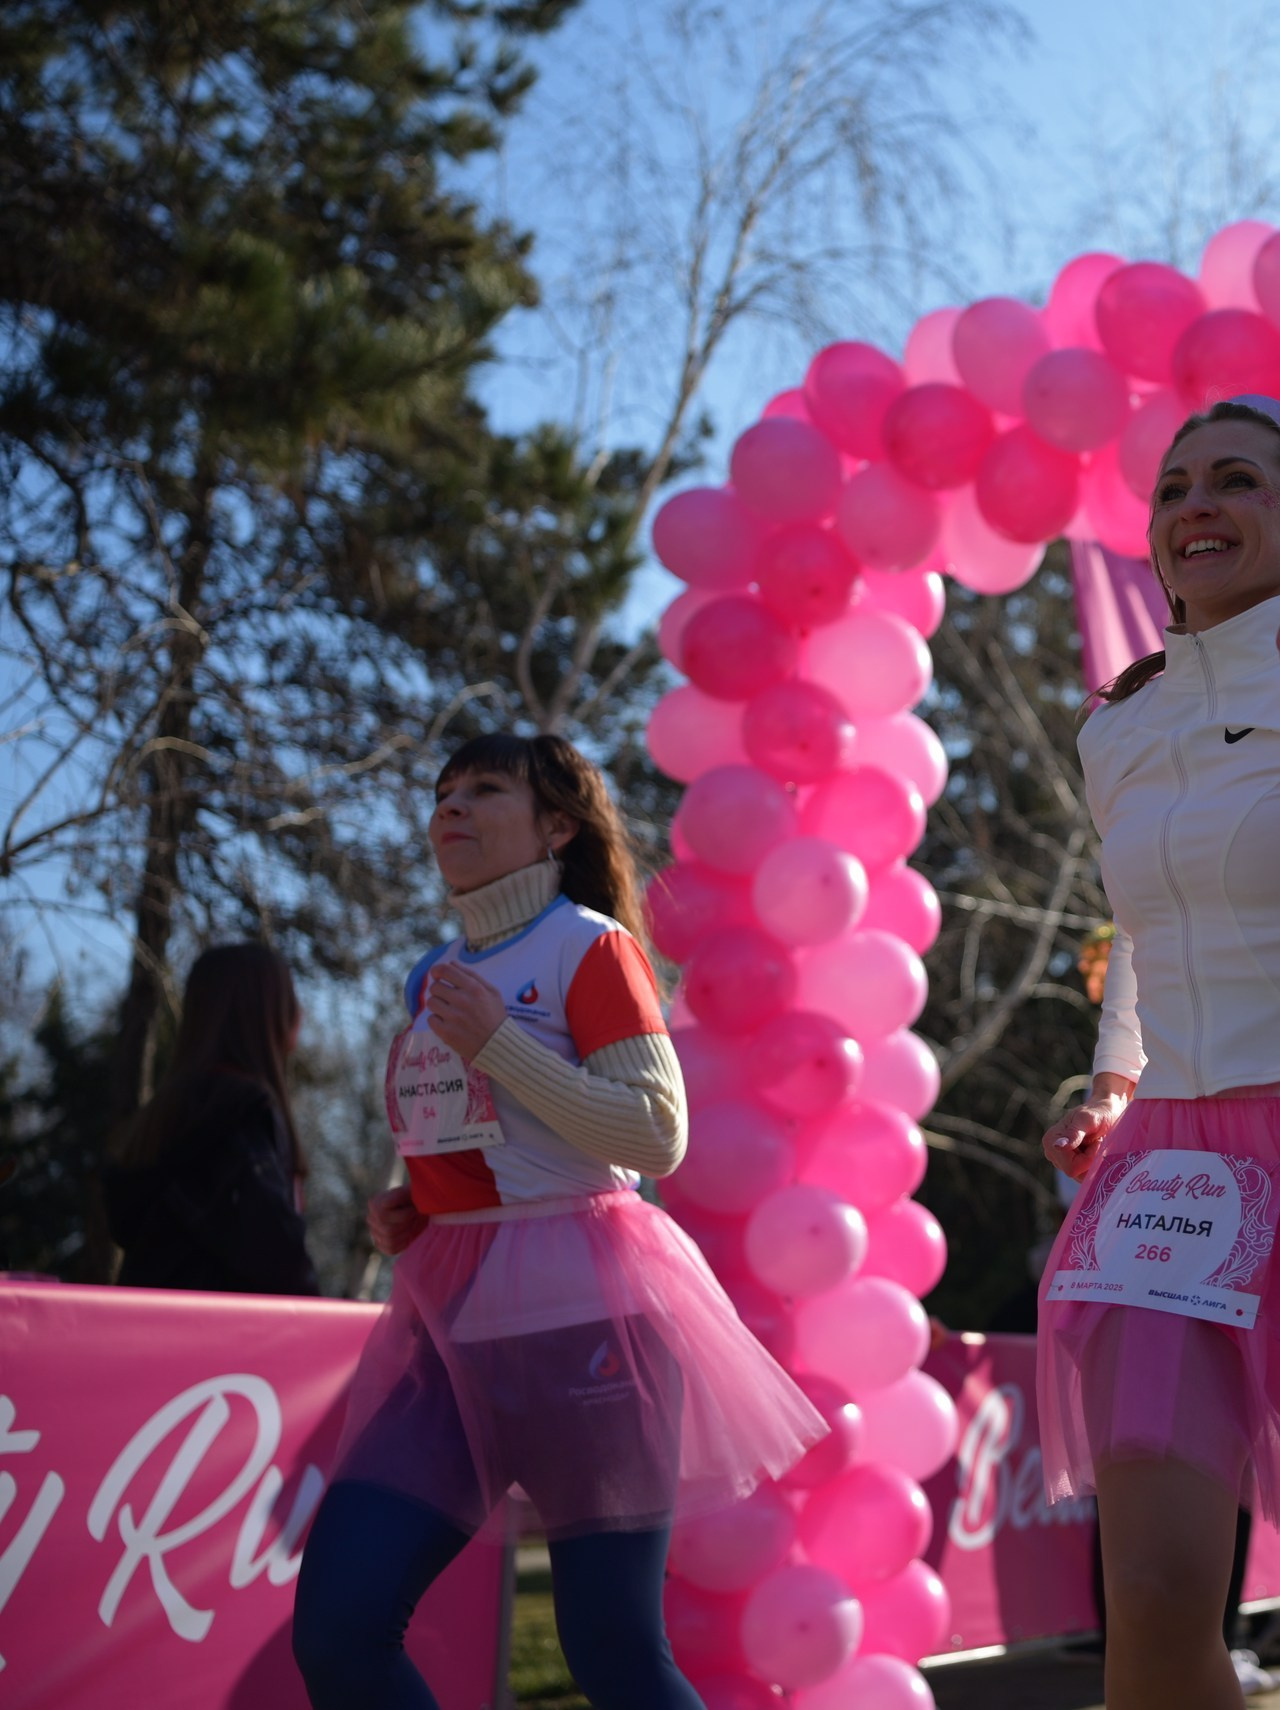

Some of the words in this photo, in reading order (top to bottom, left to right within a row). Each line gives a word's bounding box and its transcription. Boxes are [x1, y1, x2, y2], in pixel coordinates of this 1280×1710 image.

[399, 1078, 464, 1098] АНАСТАСИЯ
[1126, 1170, 1184, 1200] Beauty
[1185, 1173, 1227, 1200] Run
[1116, 1213, 1213, 1237] НАТАЛЬЯ
[1134, 1243, 1172, 1263] 266
[1076, 1282, 1103, 1291] МАРТА
[1103, 1283, 1124, 1292] 2025
[1148, 1289, 1189, 1302] ВЫСШАЯ
[1202, 1299, 1227, 1310] ЛИГА
[87, 1373, 324, 1643] Ru
